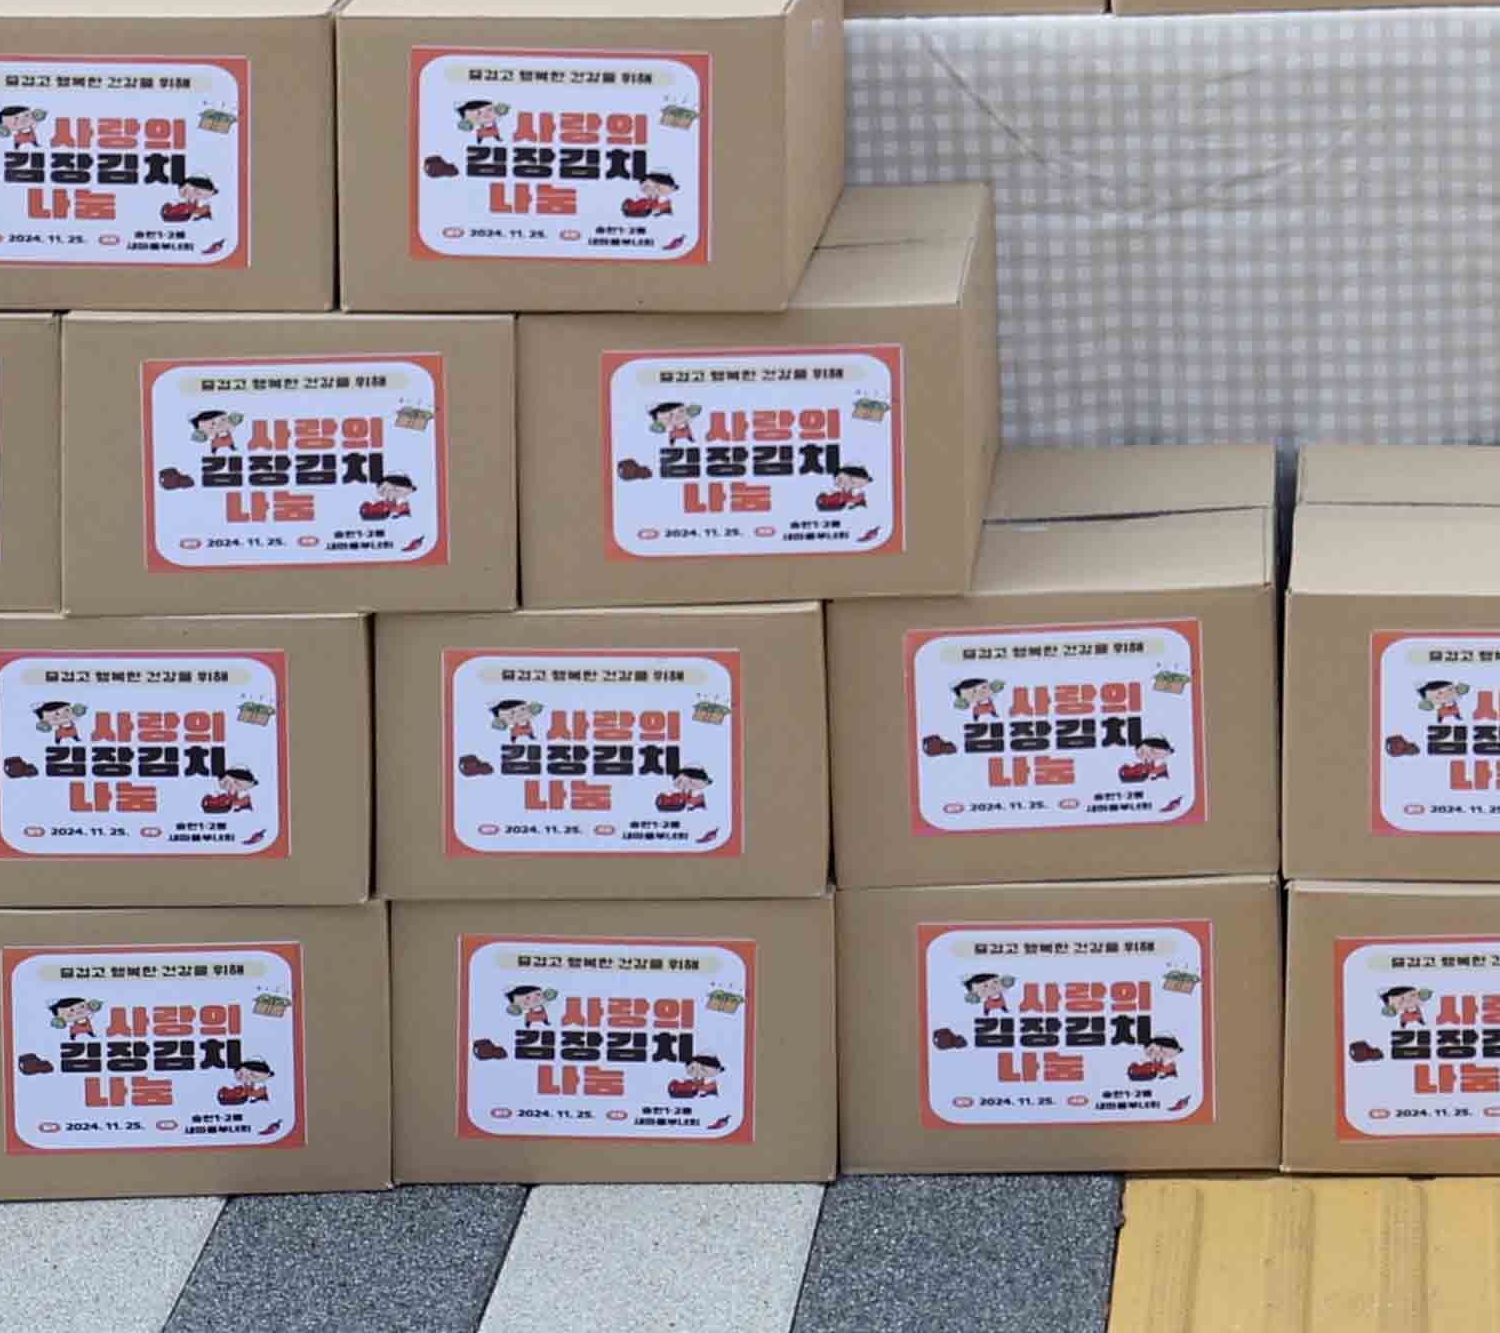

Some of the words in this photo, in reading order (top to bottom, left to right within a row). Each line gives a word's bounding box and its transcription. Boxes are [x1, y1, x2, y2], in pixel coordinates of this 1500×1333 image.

[50, 117, 186, 149] 사랑의
[4, 151, 186, 185] 김장김치
[27, 187, 116, 219] 나눔
